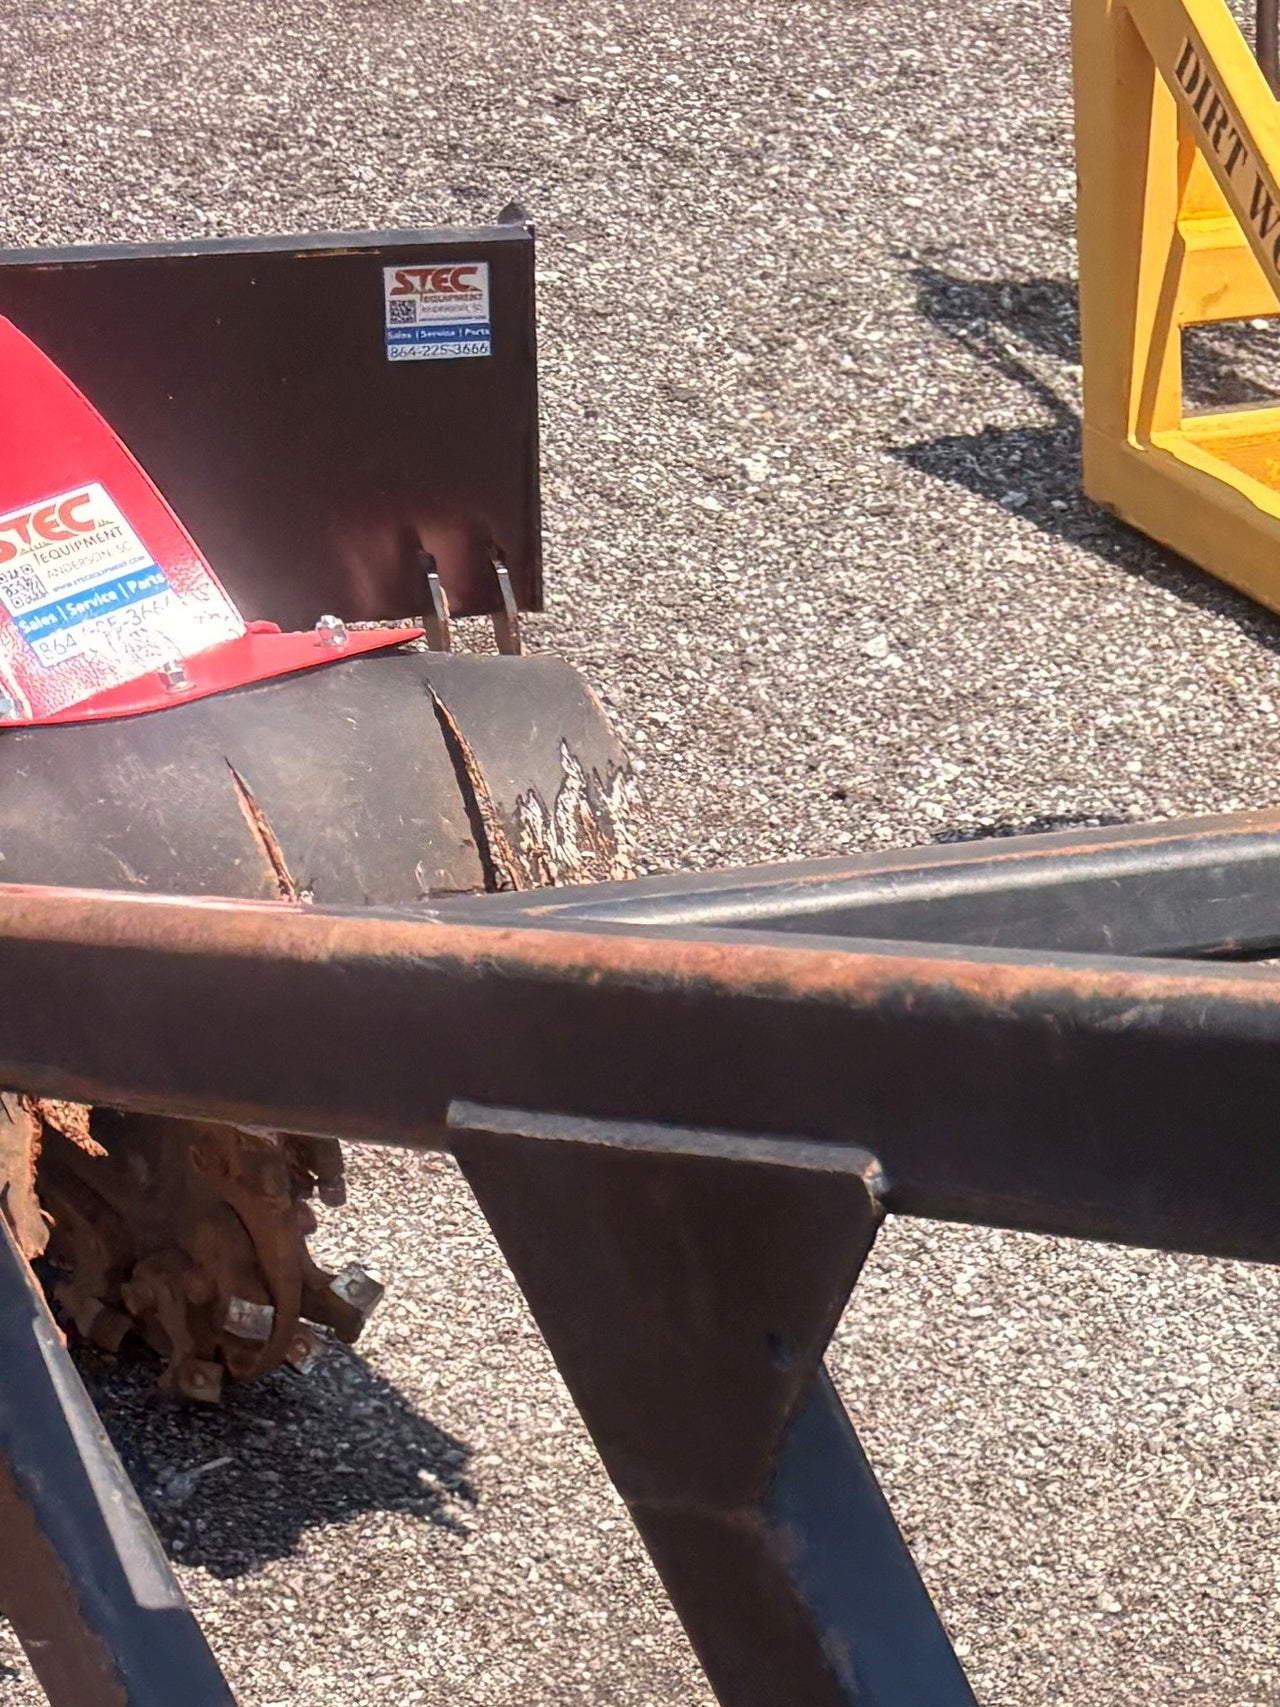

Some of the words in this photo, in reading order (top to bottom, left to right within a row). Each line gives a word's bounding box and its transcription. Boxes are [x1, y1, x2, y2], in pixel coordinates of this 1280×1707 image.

[1174, 39, 1248, 180] DIRT
[390, 267, 479, 295] STEC
[40, 526, 124, 564] EQUIPMENT
[18, 611, 58, 635] Sales
[67, 588, 119, 615] Service
